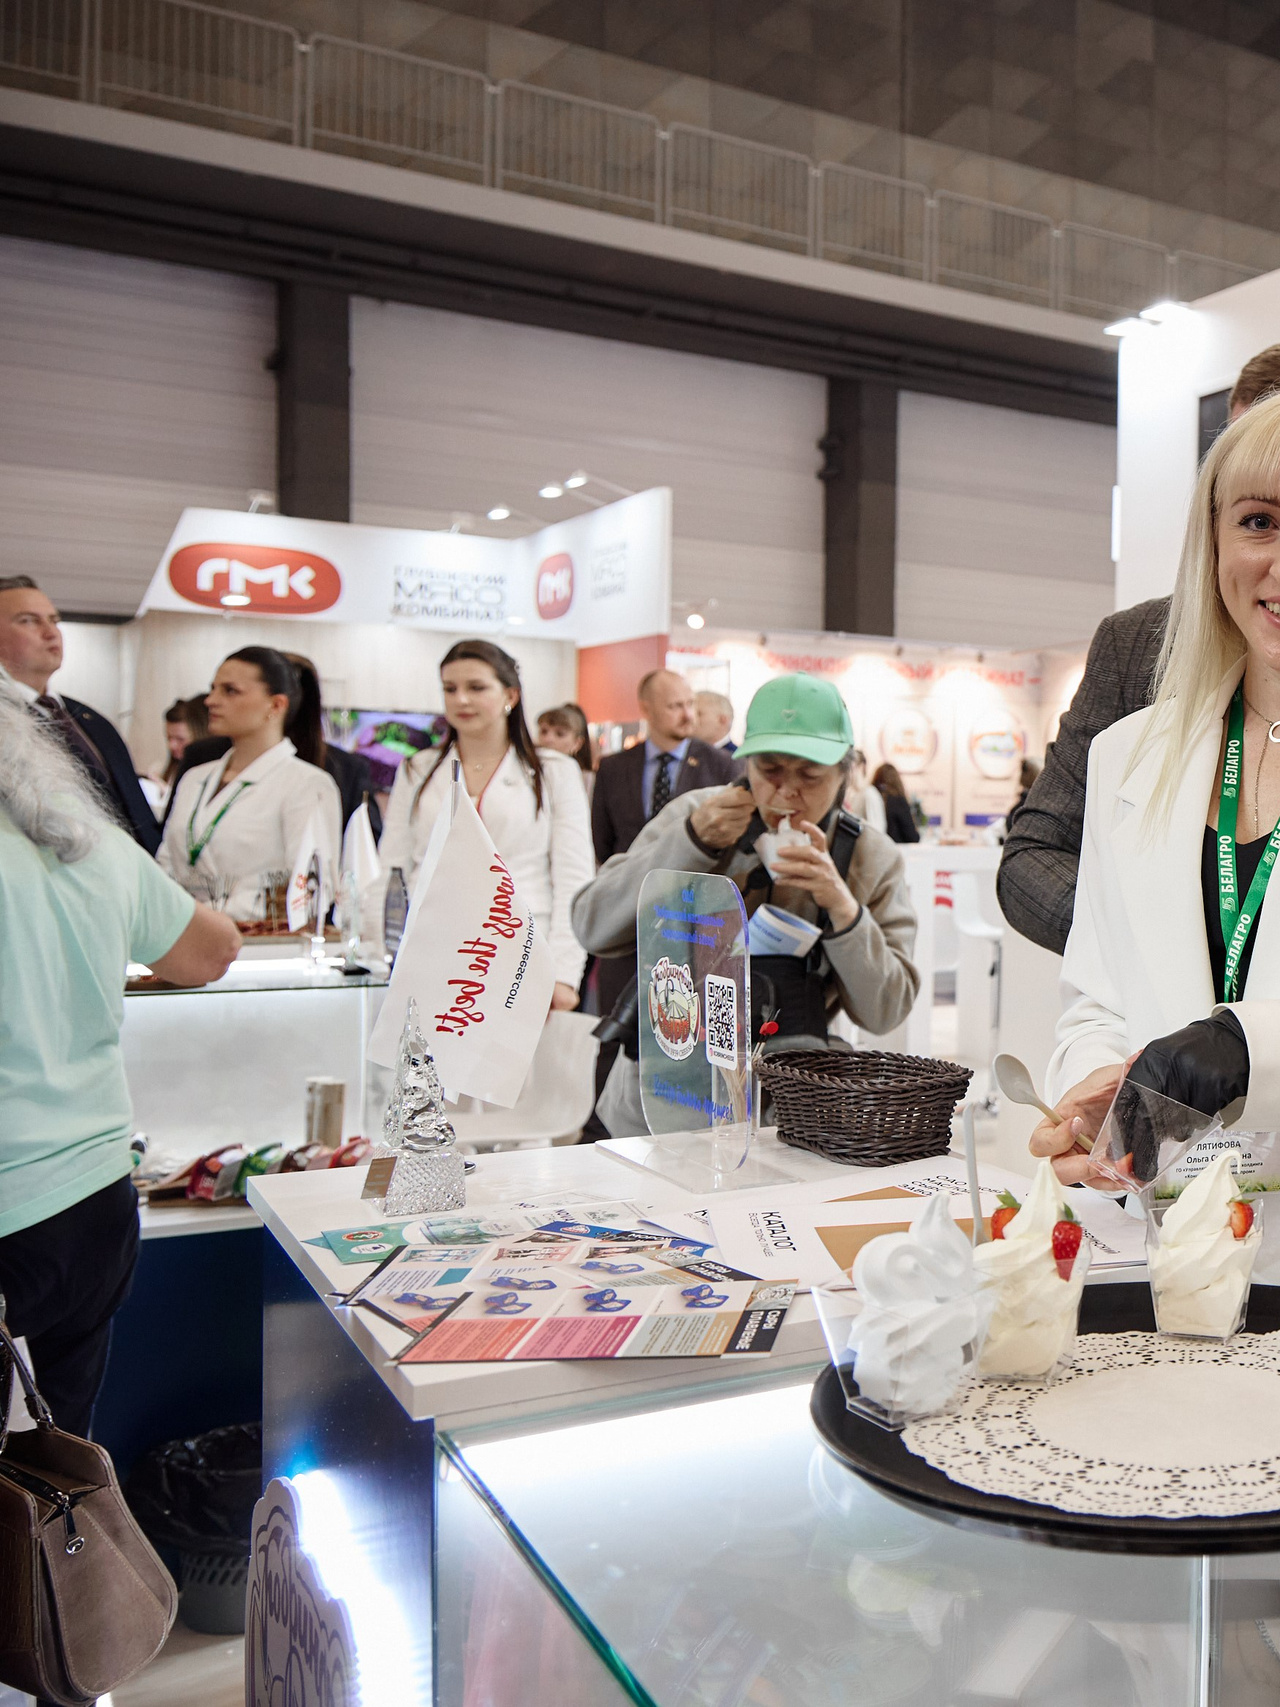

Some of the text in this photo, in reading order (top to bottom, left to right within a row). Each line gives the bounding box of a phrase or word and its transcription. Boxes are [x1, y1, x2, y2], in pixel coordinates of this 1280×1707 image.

[1224, 739, 1240, 785] БЕЛАГРО
[1221, 835, 1233, 893] БЕЛАГРО
[1225, 913, 1252, 977] БЕЛАГРО
[1186, 1155, 1209, 1164] Ольга
[1196, 1140, 1241, 1151] ЛЯТИФОВА
[761, 1211, 797, 1251] КАТАЛОГ
[762, 1310, 781, 1330] СЫРЫ
